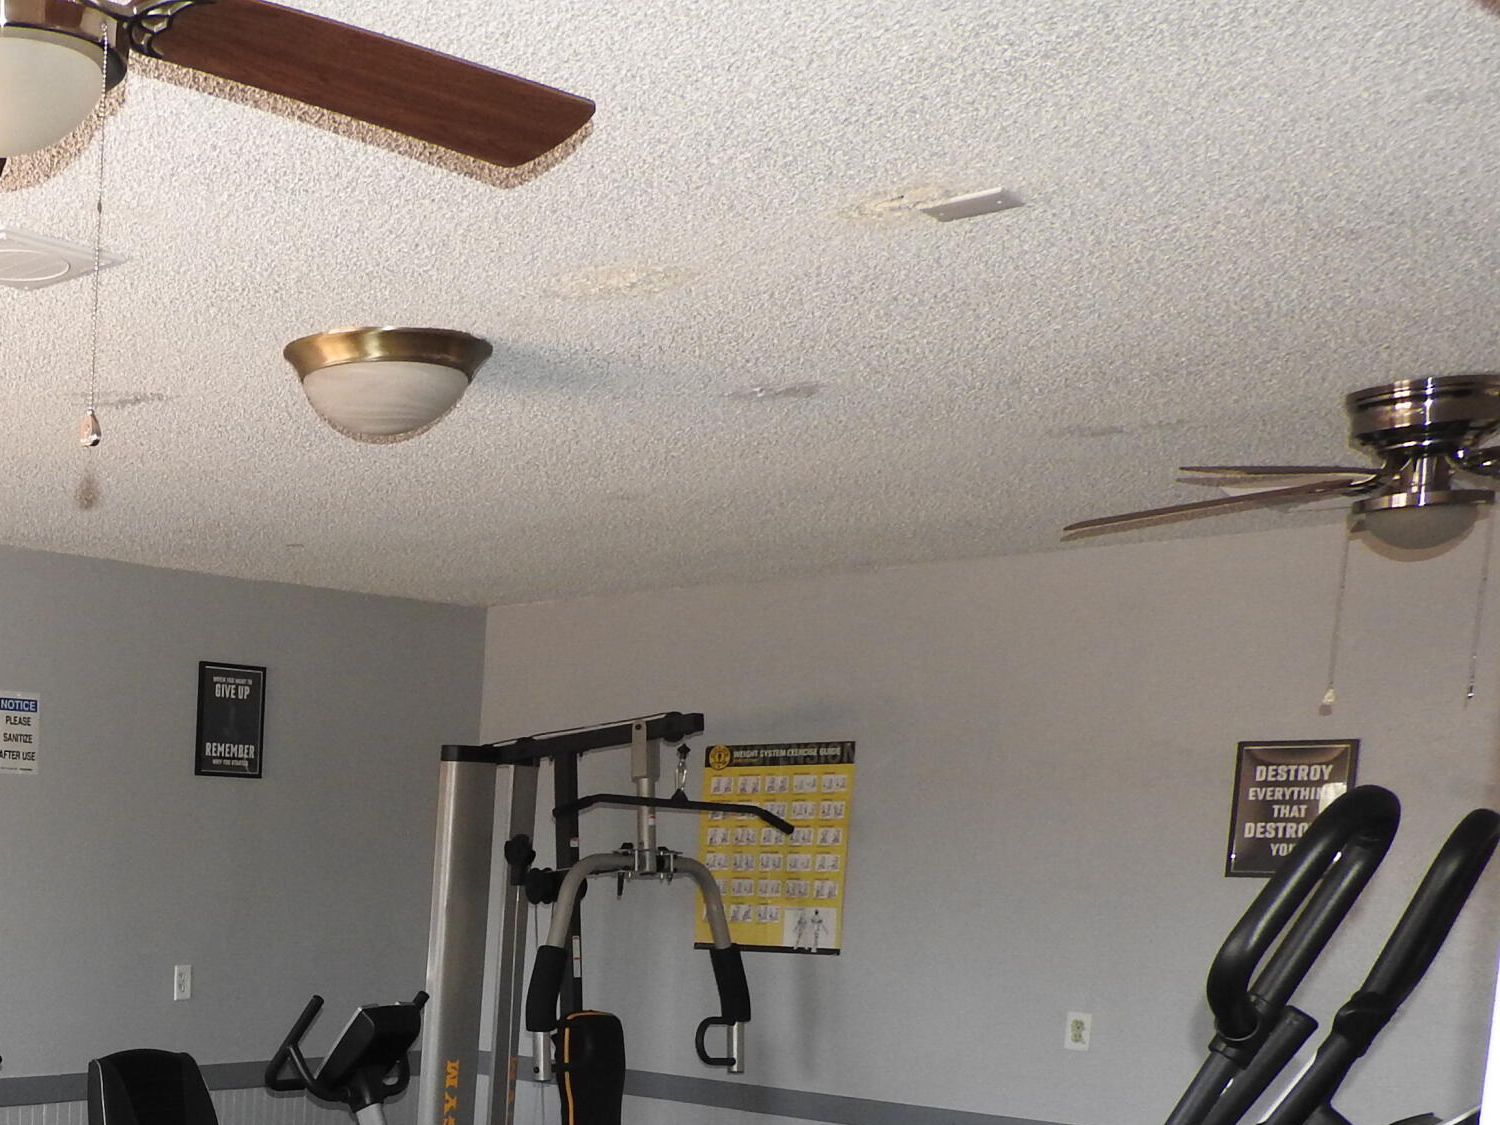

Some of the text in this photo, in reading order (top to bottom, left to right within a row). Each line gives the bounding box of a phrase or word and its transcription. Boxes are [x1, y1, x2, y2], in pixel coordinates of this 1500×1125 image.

[215, 683, 250, 700] GIVE UP
[0, 699, 37, 712] NOTICE
[5, 715, 31, 727] PLEASE
[3, 732, 33, 744] SANITIZE
[22, 751, 35, 762] USE
[205, 742, 255, 759] REMEMBER
[733, 750, 758, 759] WEIGHT
[760, 749, 786, 758] SYSTEM
[1255, 764, 1333, 781] DESTROY
[1248, 786, 1322, 800] EVERYTHI
[1272, 804, 1308, 818] THAT
[1244, 822, 1312, 839] DESTRO
